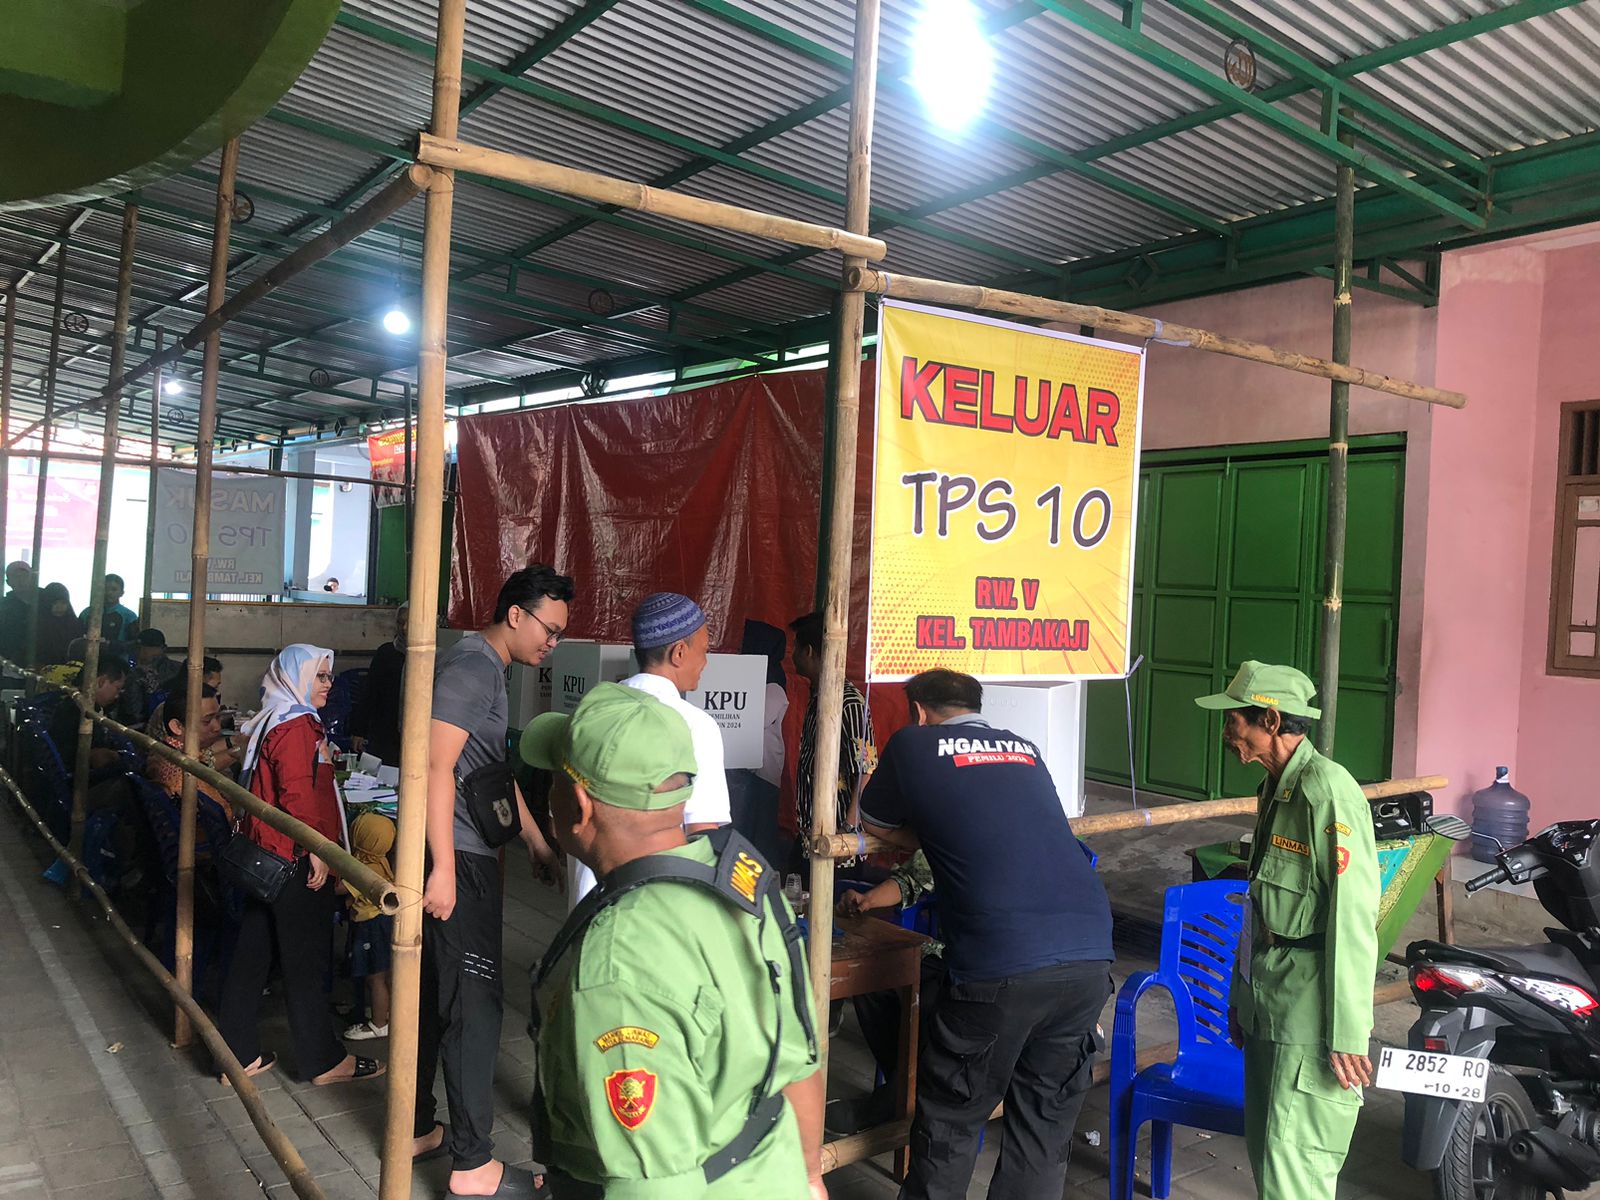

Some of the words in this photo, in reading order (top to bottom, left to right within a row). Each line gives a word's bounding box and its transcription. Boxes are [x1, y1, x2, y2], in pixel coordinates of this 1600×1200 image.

[901, 356, 1120, 447] KELUAR
[902, 472, 1016, 541] TPS
[1037, 485, 1111, 548] 10
[975, 576, 1018, 611] RW.
[1022, 578, 1040, 611] V
[916, 615, 966, 650] KEL.
[969, 617, 1089, 651] TAMBAKAJI
[563, 675, 585, 694] KPU
[704, 691, 747, 710] KPU
[1275, 837, 1308, 854] LINMAS
[1381, 1050, 1393, 1068] H
[1405, 1053, 1448, 1074] 2852
